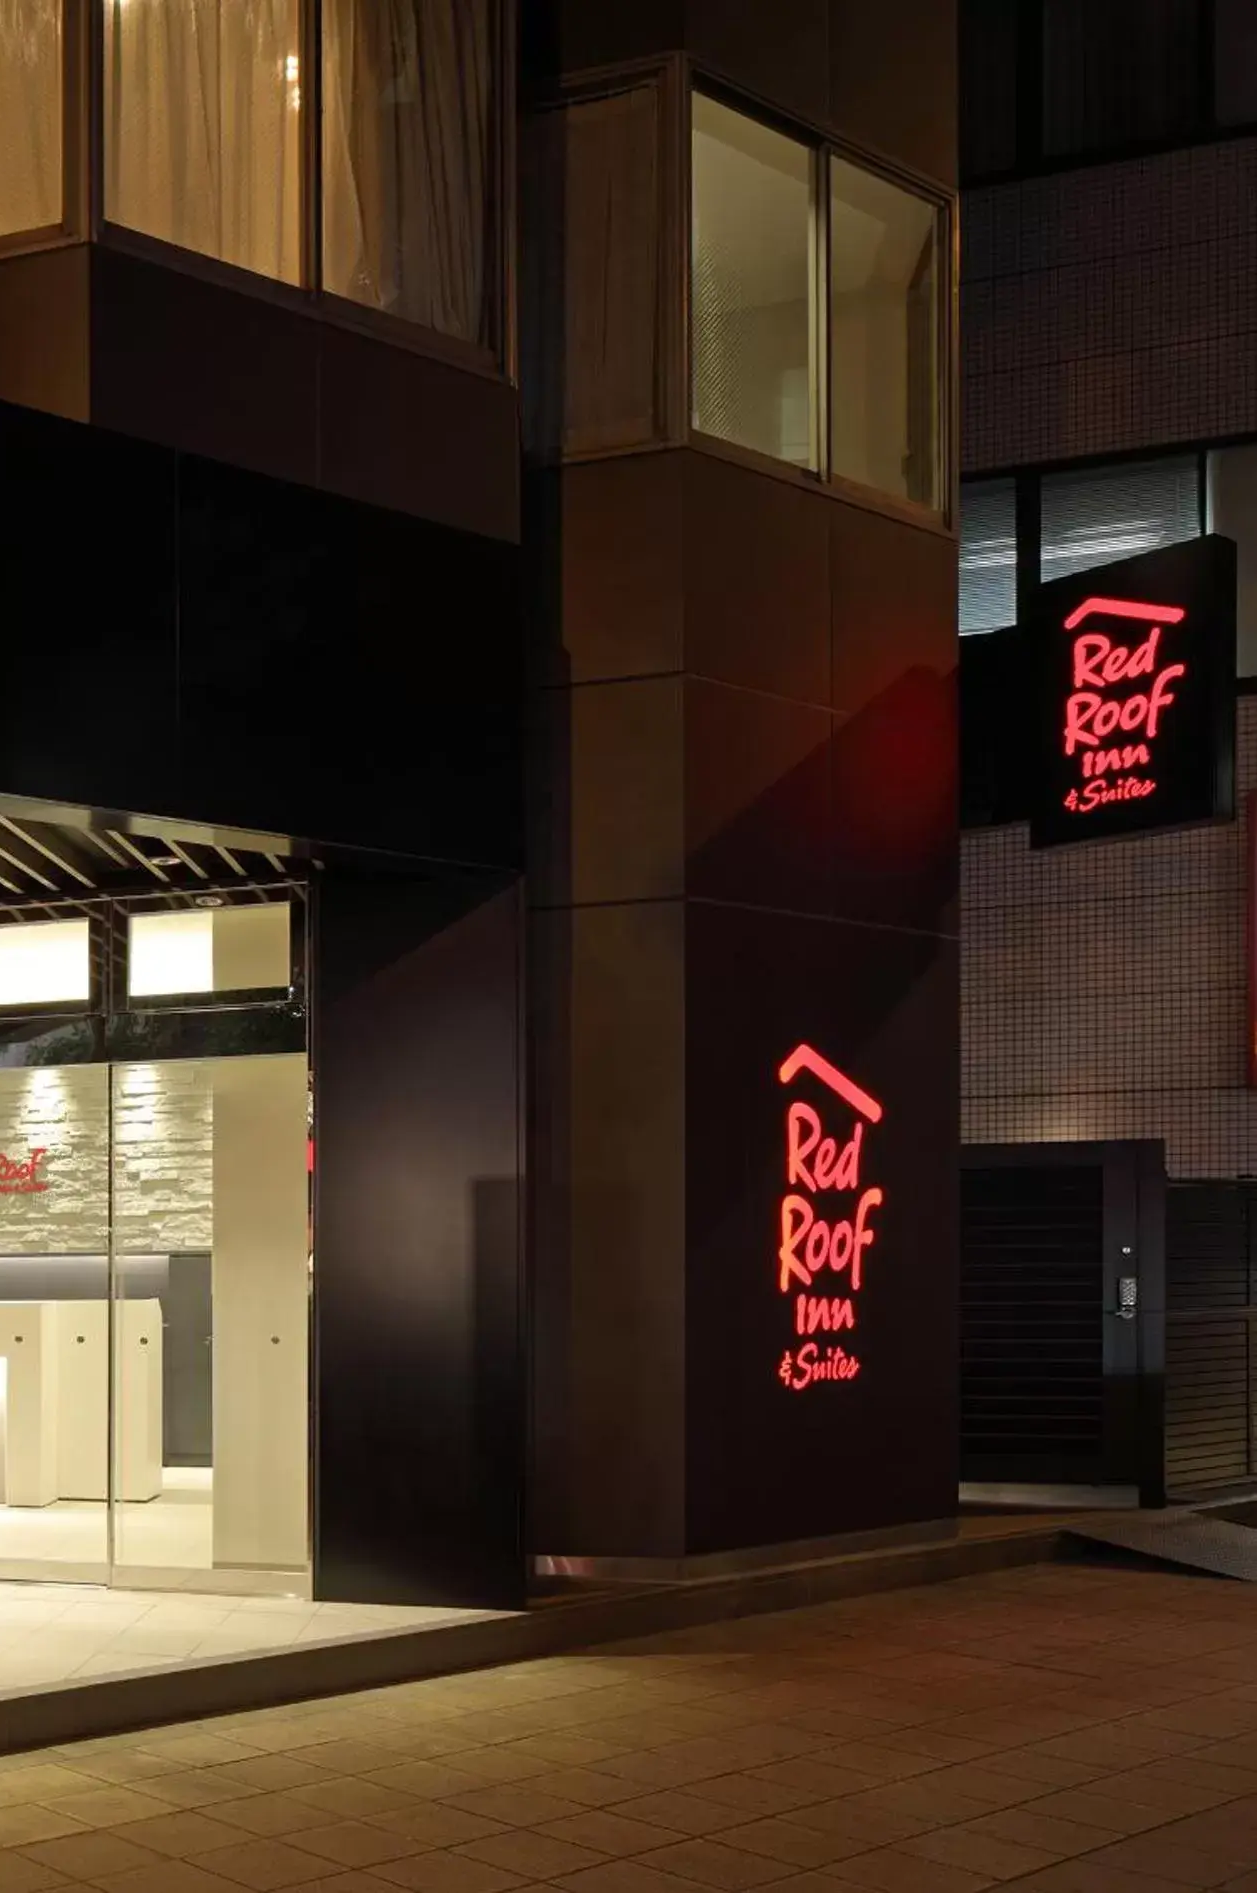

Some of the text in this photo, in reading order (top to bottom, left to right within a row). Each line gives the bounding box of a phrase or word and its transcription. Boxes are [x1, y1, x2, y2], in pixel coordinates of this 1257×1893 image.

[1073, 627, 1160, 688] Red
[1064, 664, 1185, 755] Roof
[1082, 744, 1150, 778] Inn
[1064, 777, 1156, 812] & Suites
[788, 1102, 863, 1193] Red
[778, 1187, 883, 1292] Roof
[796, 1294, 855, 1335] Inn
[778, 1342, 860, 1391] & Suites
